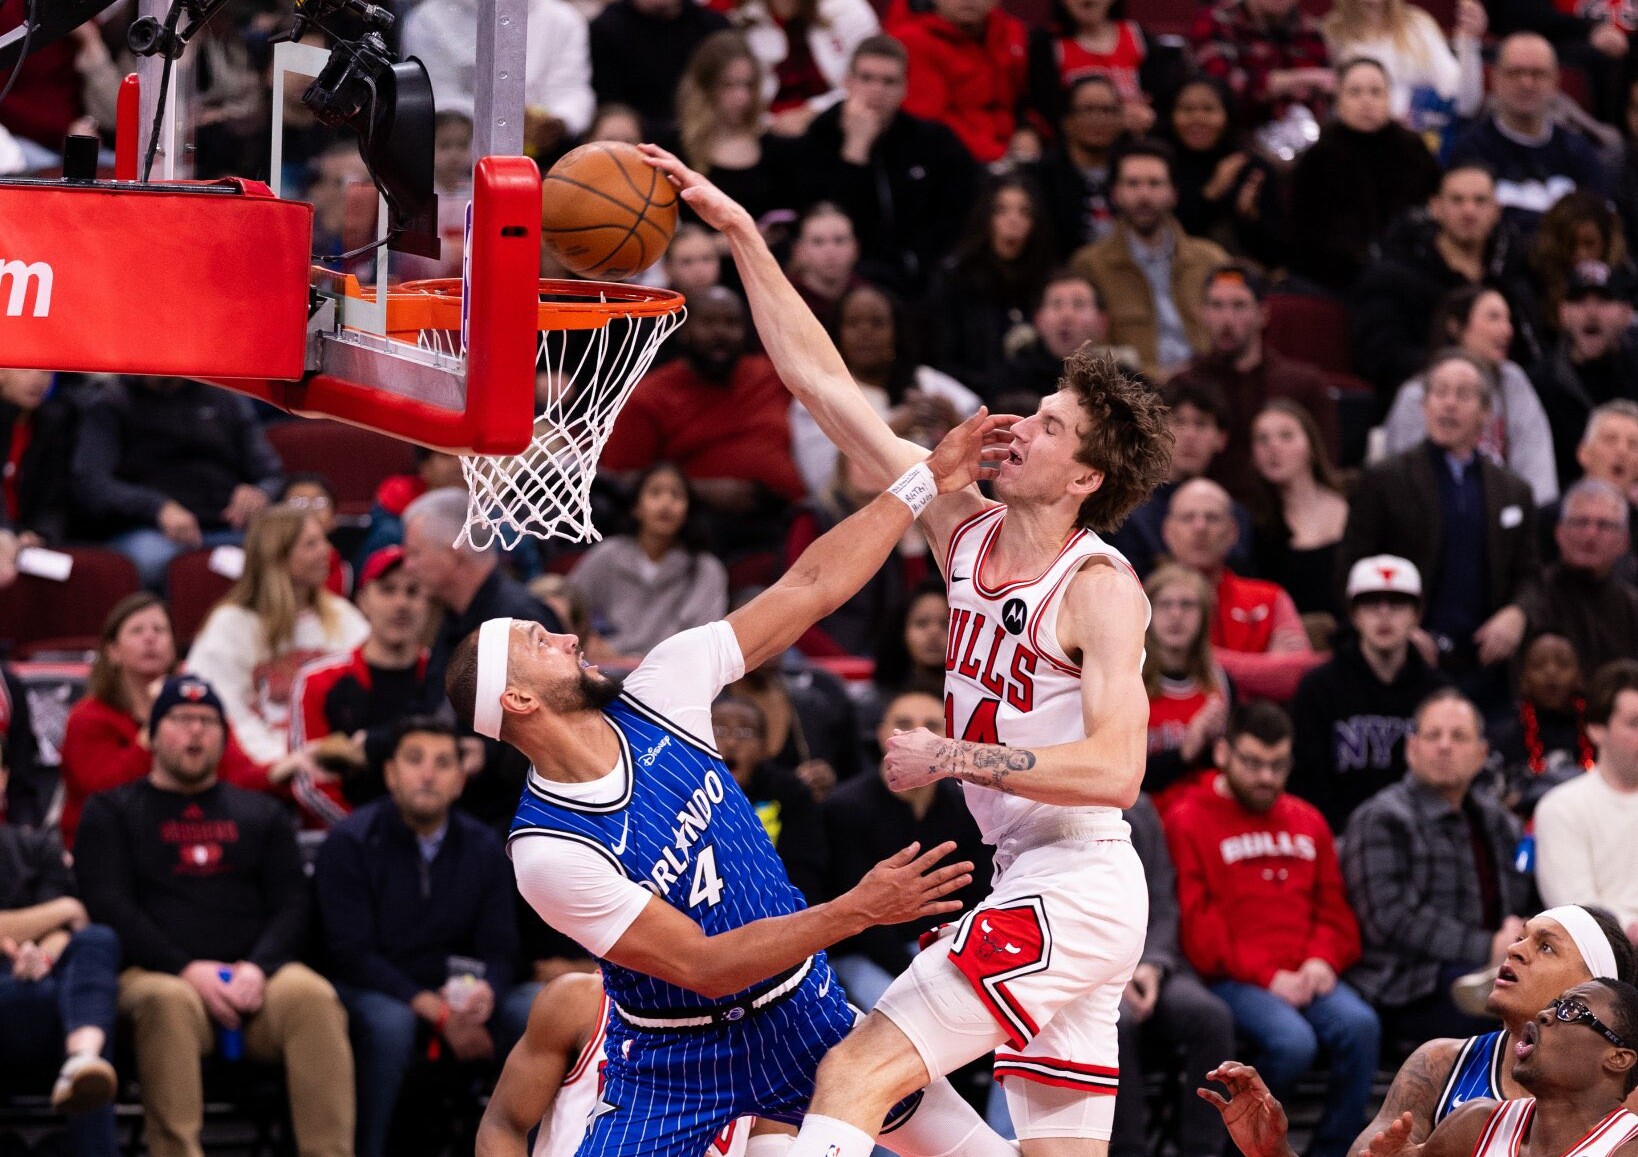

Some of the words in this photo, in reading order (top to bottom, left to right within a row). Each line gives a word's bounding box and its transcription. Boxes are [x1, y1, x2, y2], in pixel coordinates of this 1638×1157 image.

[0, 258, 54, 317] m
[945, 606, 1039, 713] ULLS
[638, 735, 671, 767] Disney
[1335, 714, 1415, 771] NY
[689, 845, 724, 908] 4
